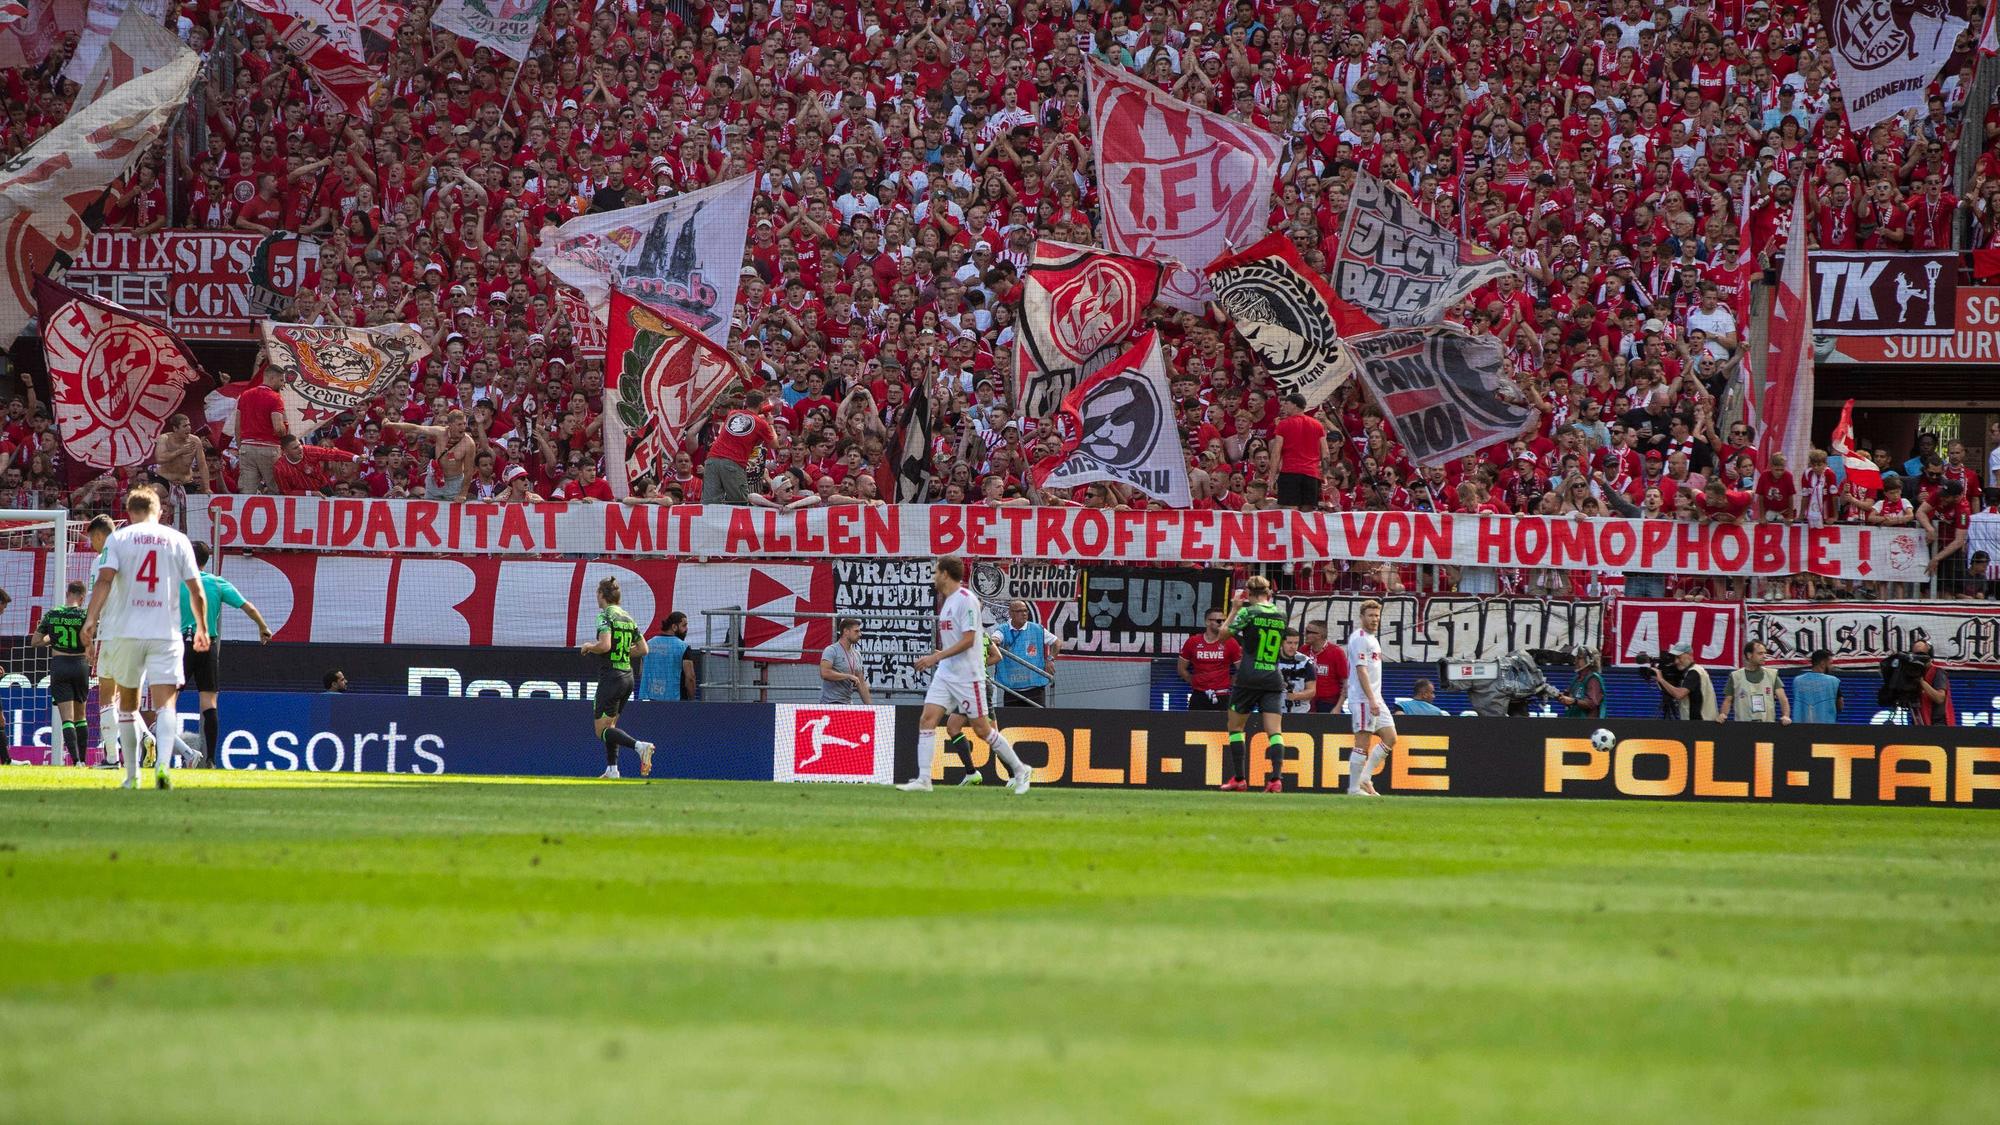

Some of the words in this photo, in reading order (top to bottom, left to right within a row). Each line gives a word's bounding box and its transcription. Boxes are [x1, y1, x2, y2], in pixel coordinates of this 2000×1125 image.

[1867, 30, 1905, 63] KÖLN
[1700, 78, 1721, 87] REWE
[1818, 150, 1844, 159] RWE
[175, 238, 252, 274] SPS
[175, 283, 251, 317] CGN
[1816, 260, 1891, 322] TK
[1298, 362, 1327, 387] ULTRA
[209, 496, 568, 550] SOLIDARITÄT
[604, 503, 702, 553] MIT
[725, 503, 899, 554] ALLEN
[929, 504, 1329, 561] BETROFFENEN
[1341, 511, 1454, 560] VON
[1478, 516, 1841, 577] HOMOPHOBIE
[136, 551, 160, 593] 4
[833, 560, 935, 584] VIRAGE
[835, 584, 934, 607] AUTEUIL
[54, 625, 78, 649] 31
[610, 630, 633, 662] 39
[1256, 628, 1281, 663] 19
[1748, 613, 1931, 661] Kölsche
[1196, 650, 1225, 660] REWE
[931, 726, 1450, 792] POLI-TAPE
